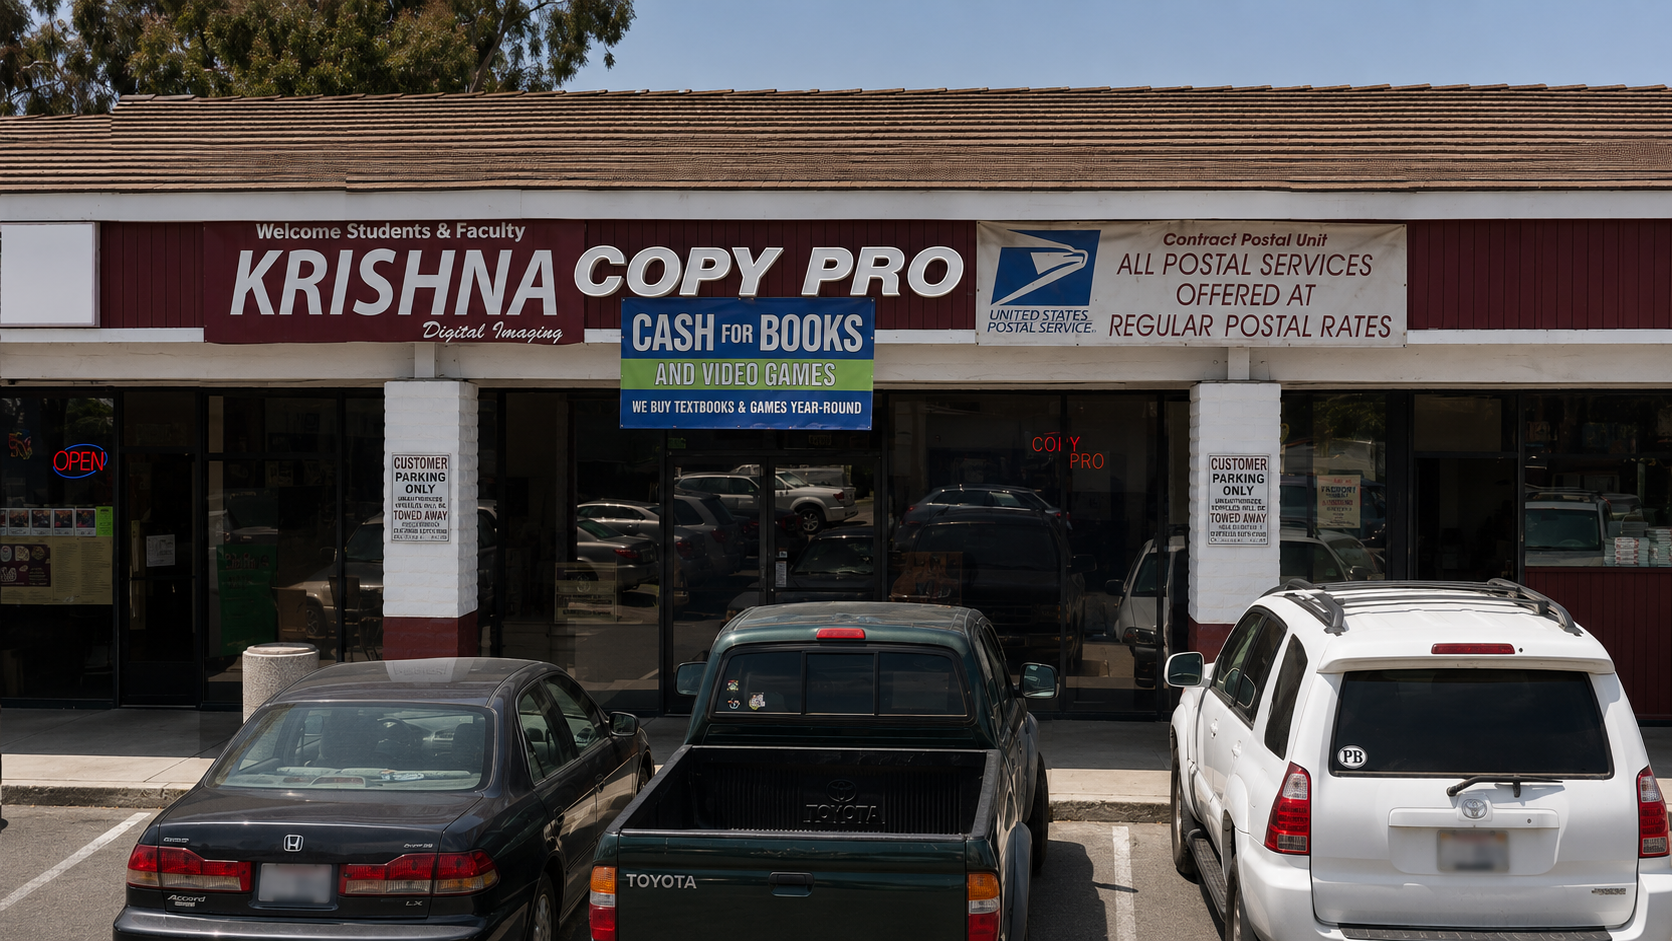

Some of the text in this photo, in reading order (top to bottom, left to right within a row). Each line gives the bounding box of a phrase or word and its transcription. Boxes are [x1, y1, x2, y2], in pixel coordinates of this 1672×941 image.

[255, 222, 526, 242] Welcome Students & Faculty
[1163, 232, 1328, 247] Contract Postal Unit
[573, 245, 965, 298] COPY PRO
[1116, 252, 1374, 276] ALL POSTAL SERVICES
[230, 248, 557, 316] KRISHNA
[1176, 282, 1317, 307] OFFERED AT
[989, 309, 1089, 321] UNITED STATES
[422, 320, 564, 344] Digital Imaging
[632, 313, 863, 353] CASH FOR BOOKS
[987, 322, 1036, 333] POSTAL
[1109, 313, 1393, 338] REGULAR POSTAL RATES
[654, 362, 837, 387] AND VIDEO GAMES
[632, 400, 862, 415] WE BUY TEXTBOOKS & GAMES YEAR-ROUND
[53, 450, 104, 471] OPEN
[393, 456, 448, 470] CUSTOMER
[1069, 452, 1104, 469] PRO
[1211, 457, 1267, 471] CUSTOMER
[395, 471, 446, 482] PARKING
[1212, 473, 1265, 484] PARKING
[405, 484, 436, 494] ONLY
[1222, 485, 1254, 496] ONLY
[393, 509, 448, 521] TOWED AWAY
[1210, 512, 1267, 524] TOWED AWAY
[1343, 750, 1363, 763] PB
[803, 804, 886, 824] TOYOTA
[626, 873, 698, 889] TOYOTA
[167, 894, 206, 903] Accord
